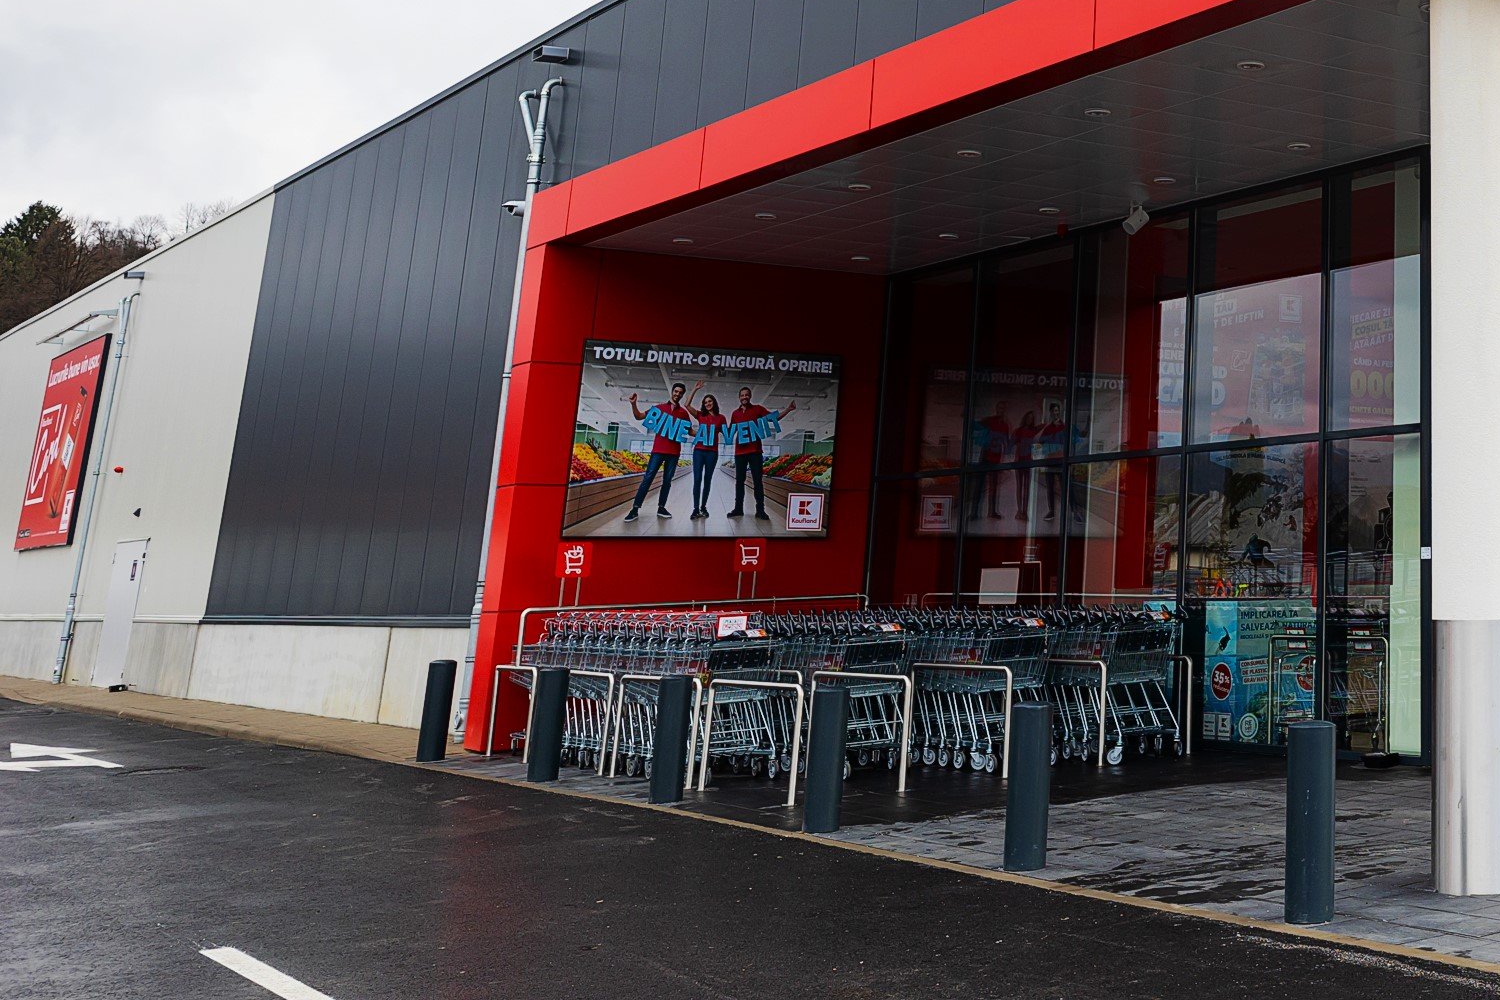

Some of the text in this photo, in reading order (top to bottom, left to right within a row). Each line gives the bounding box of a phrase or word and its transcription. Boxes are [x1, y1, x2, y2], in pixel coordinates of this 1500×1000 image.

[1350, 310, 1380, 323] IECARE
[593, 346, 832, 373] TOTUL DINTR-O SINGURĂ OPRIRE!
[642, 405, 782, 446] BINE AI VENIT
[1240, 610, 1298, 619] IMPLICAREA TA
[1213, 670, 1230, 684] 35%
